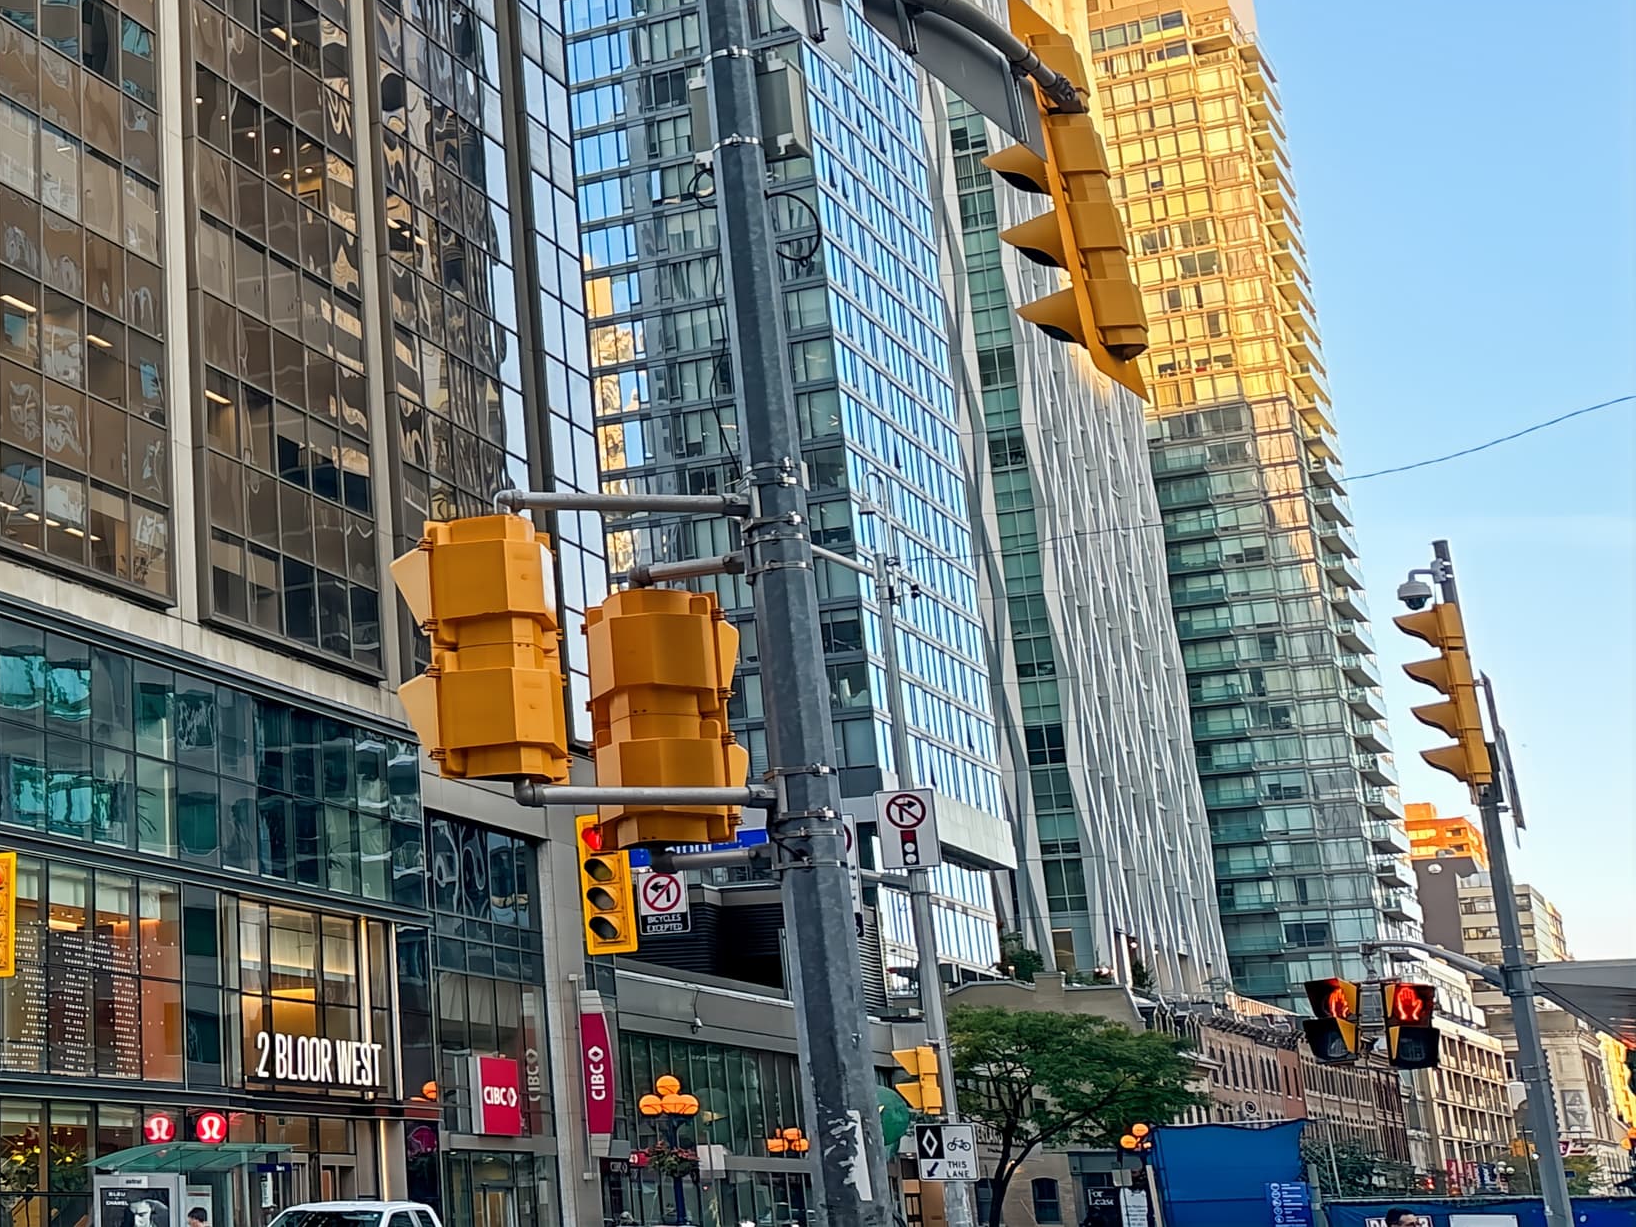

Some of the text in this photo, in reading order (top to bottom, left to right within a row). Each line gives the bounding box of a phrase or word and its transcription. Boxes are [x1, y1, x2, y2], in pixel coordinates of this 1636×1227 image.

[647, 913, 681, 923] BICYCLES
[646, 923, 683, 933] EXCEPTED
[257, 1031, 382, 1087] 2 BLOOR WEST
[589, 1063, 606, 1101] CIBC
[483, 1085, 507, 1106] CIBC
[947, 1160, 967, 1169] THIS
[946, 1170, 970, 1178] LANE
